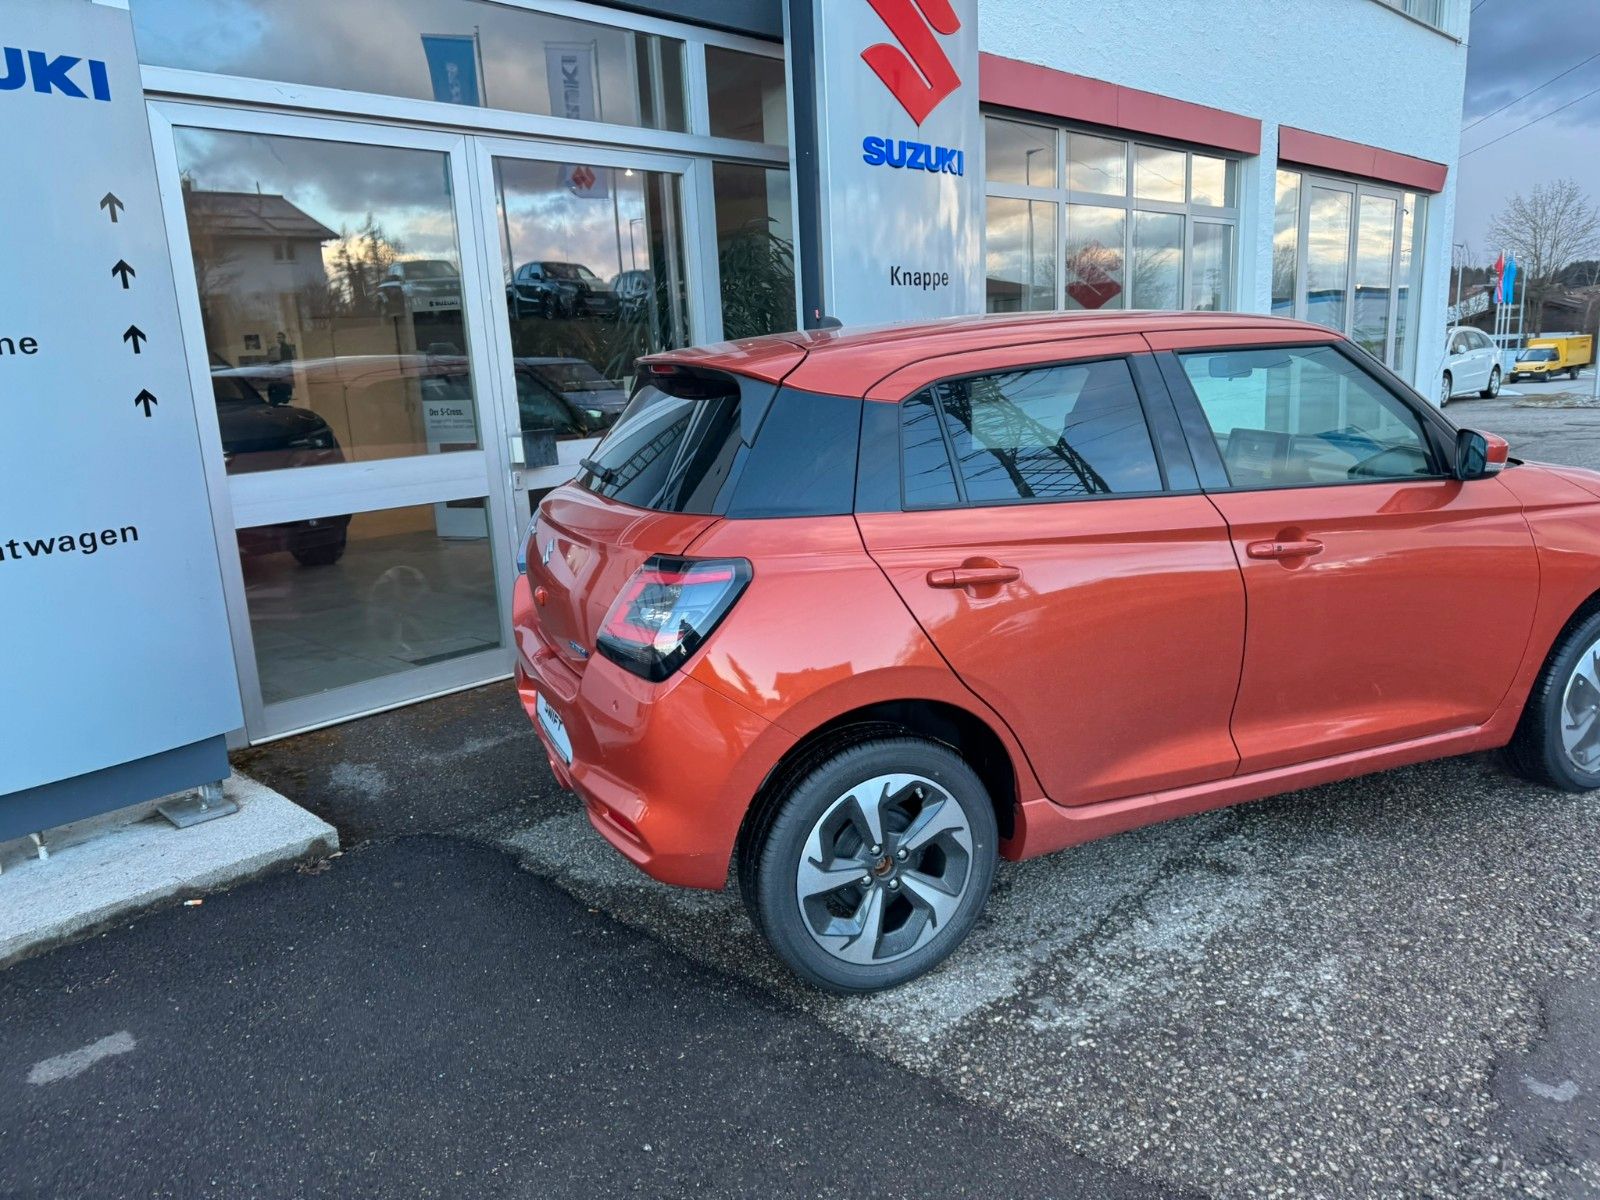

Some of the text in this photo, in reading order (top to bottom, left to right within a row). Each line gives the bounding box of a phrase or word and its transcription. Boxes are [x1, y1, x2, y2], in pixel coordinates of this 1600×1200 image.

[862, 136, 964, 177] SUZUKI
[890, 265, 949, 291] Knappe
[0, 525, 139, 561] twagen
